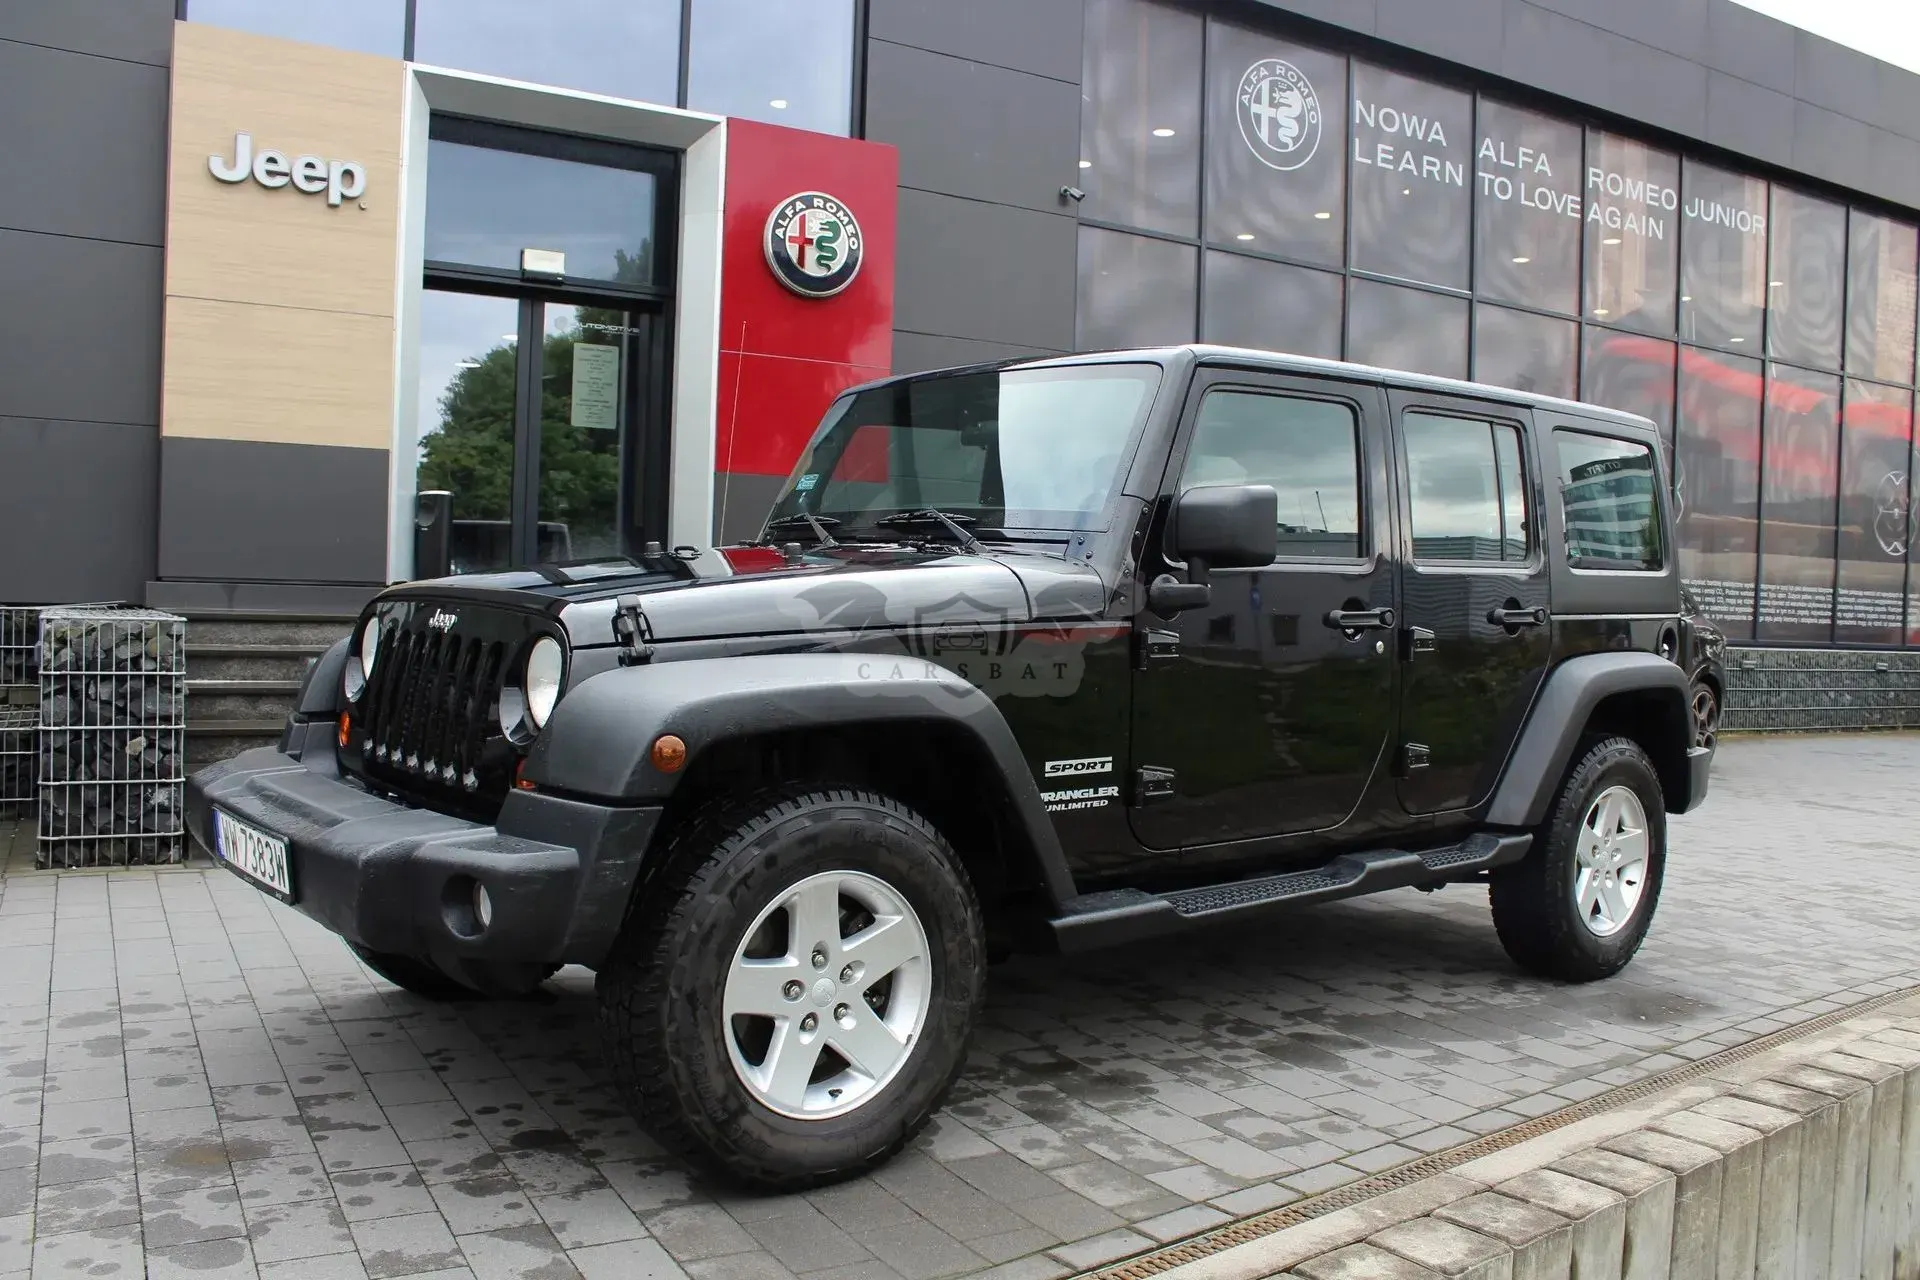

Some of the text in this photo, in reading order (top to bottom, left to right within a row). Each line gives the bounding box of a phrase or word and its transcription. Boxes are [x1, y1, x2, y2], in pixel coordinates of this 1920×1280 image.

[1240, 64, 1318, 124] ALFA ROMEO
[207, 130, 366, 207] Jeep
[1354, 138, 1665, 241] LEARN TO LOVE AGAIN
[1355, 99, 1766, 237] NOWA ALFA ROMEO JUNIOR
[774, 197, 859, 251] ALFA ROMEO
[1047, 761, 1108, 773] SPORT
